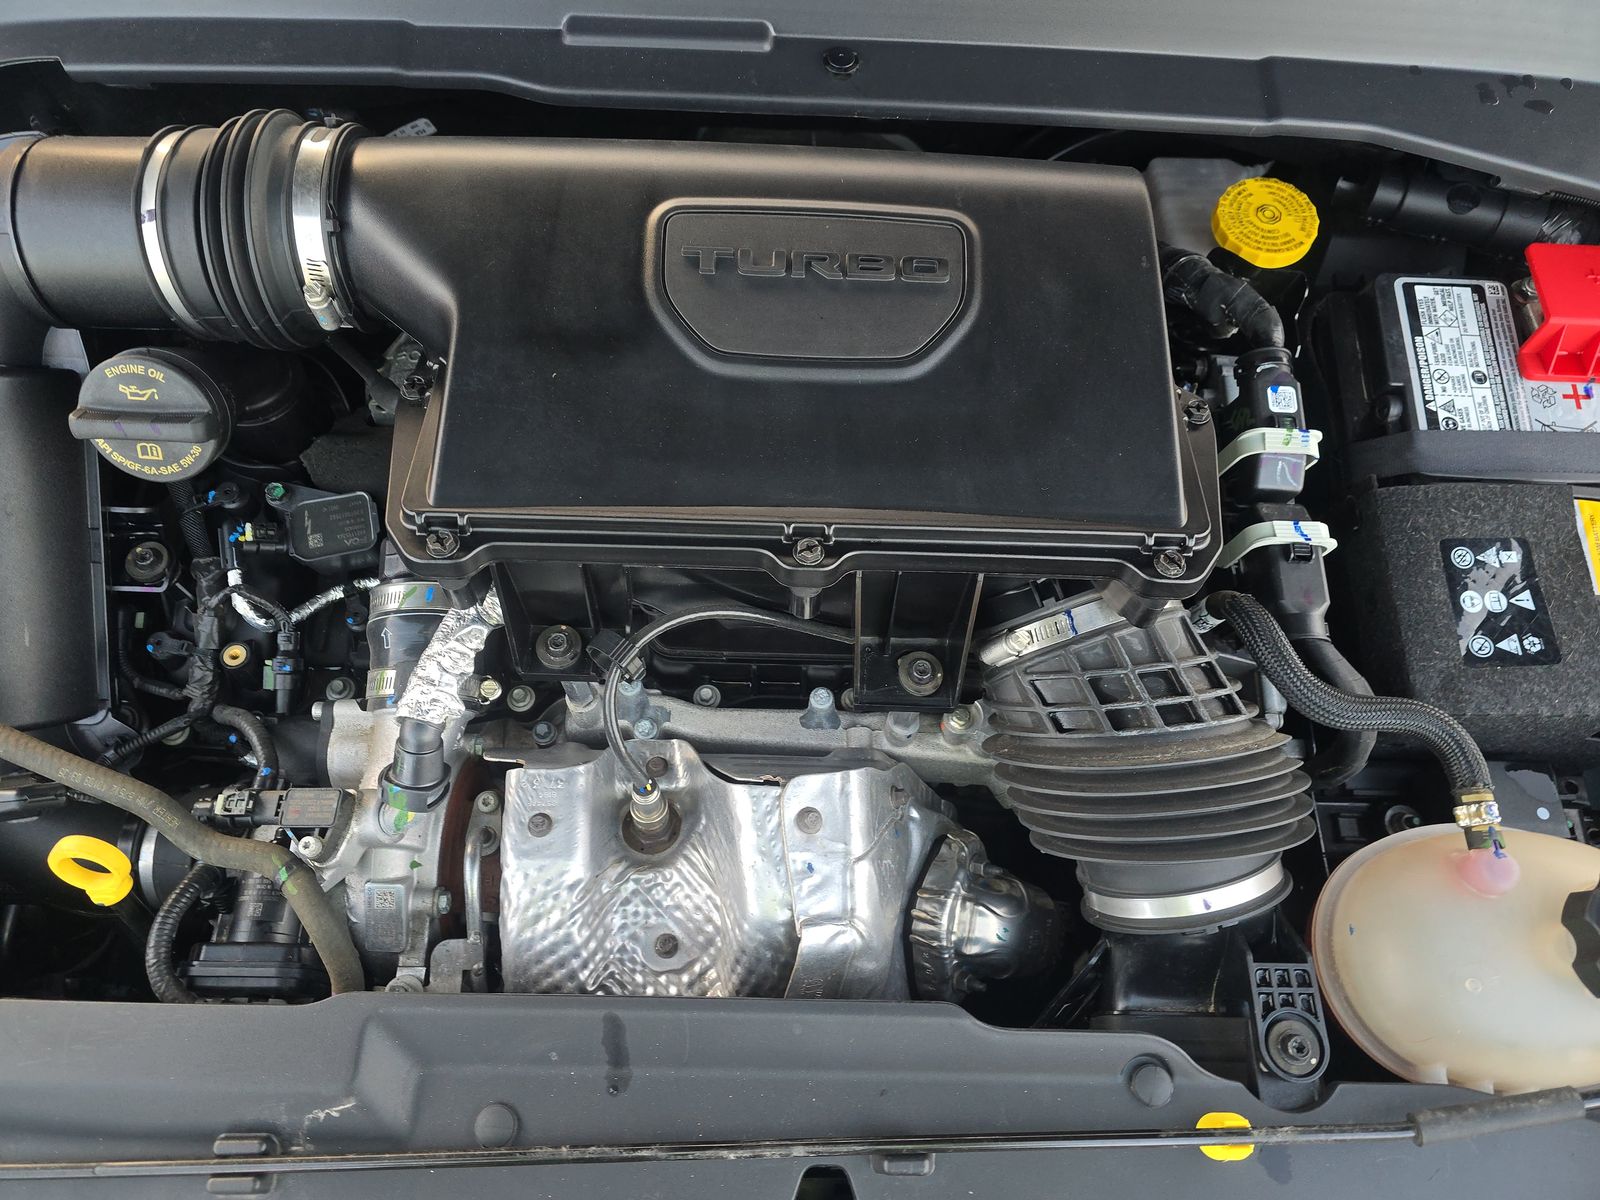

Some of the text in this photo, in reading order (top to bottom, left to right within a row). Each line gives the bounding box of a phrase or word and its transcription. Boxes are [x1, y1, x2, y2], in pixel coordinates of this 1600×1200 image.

[681, 246, 950, 283] TURBO
[1419, 311, 1427, 325] FLUSH
[104, 364, 166, 383] ENGINE OIL
[1414, 336, 1435, 401] DANGER/POISON
[1457, 408, 1465, 423] GASES
[95, 438, 112, 454] API
[180, 444, 202, 467] 5W-30
